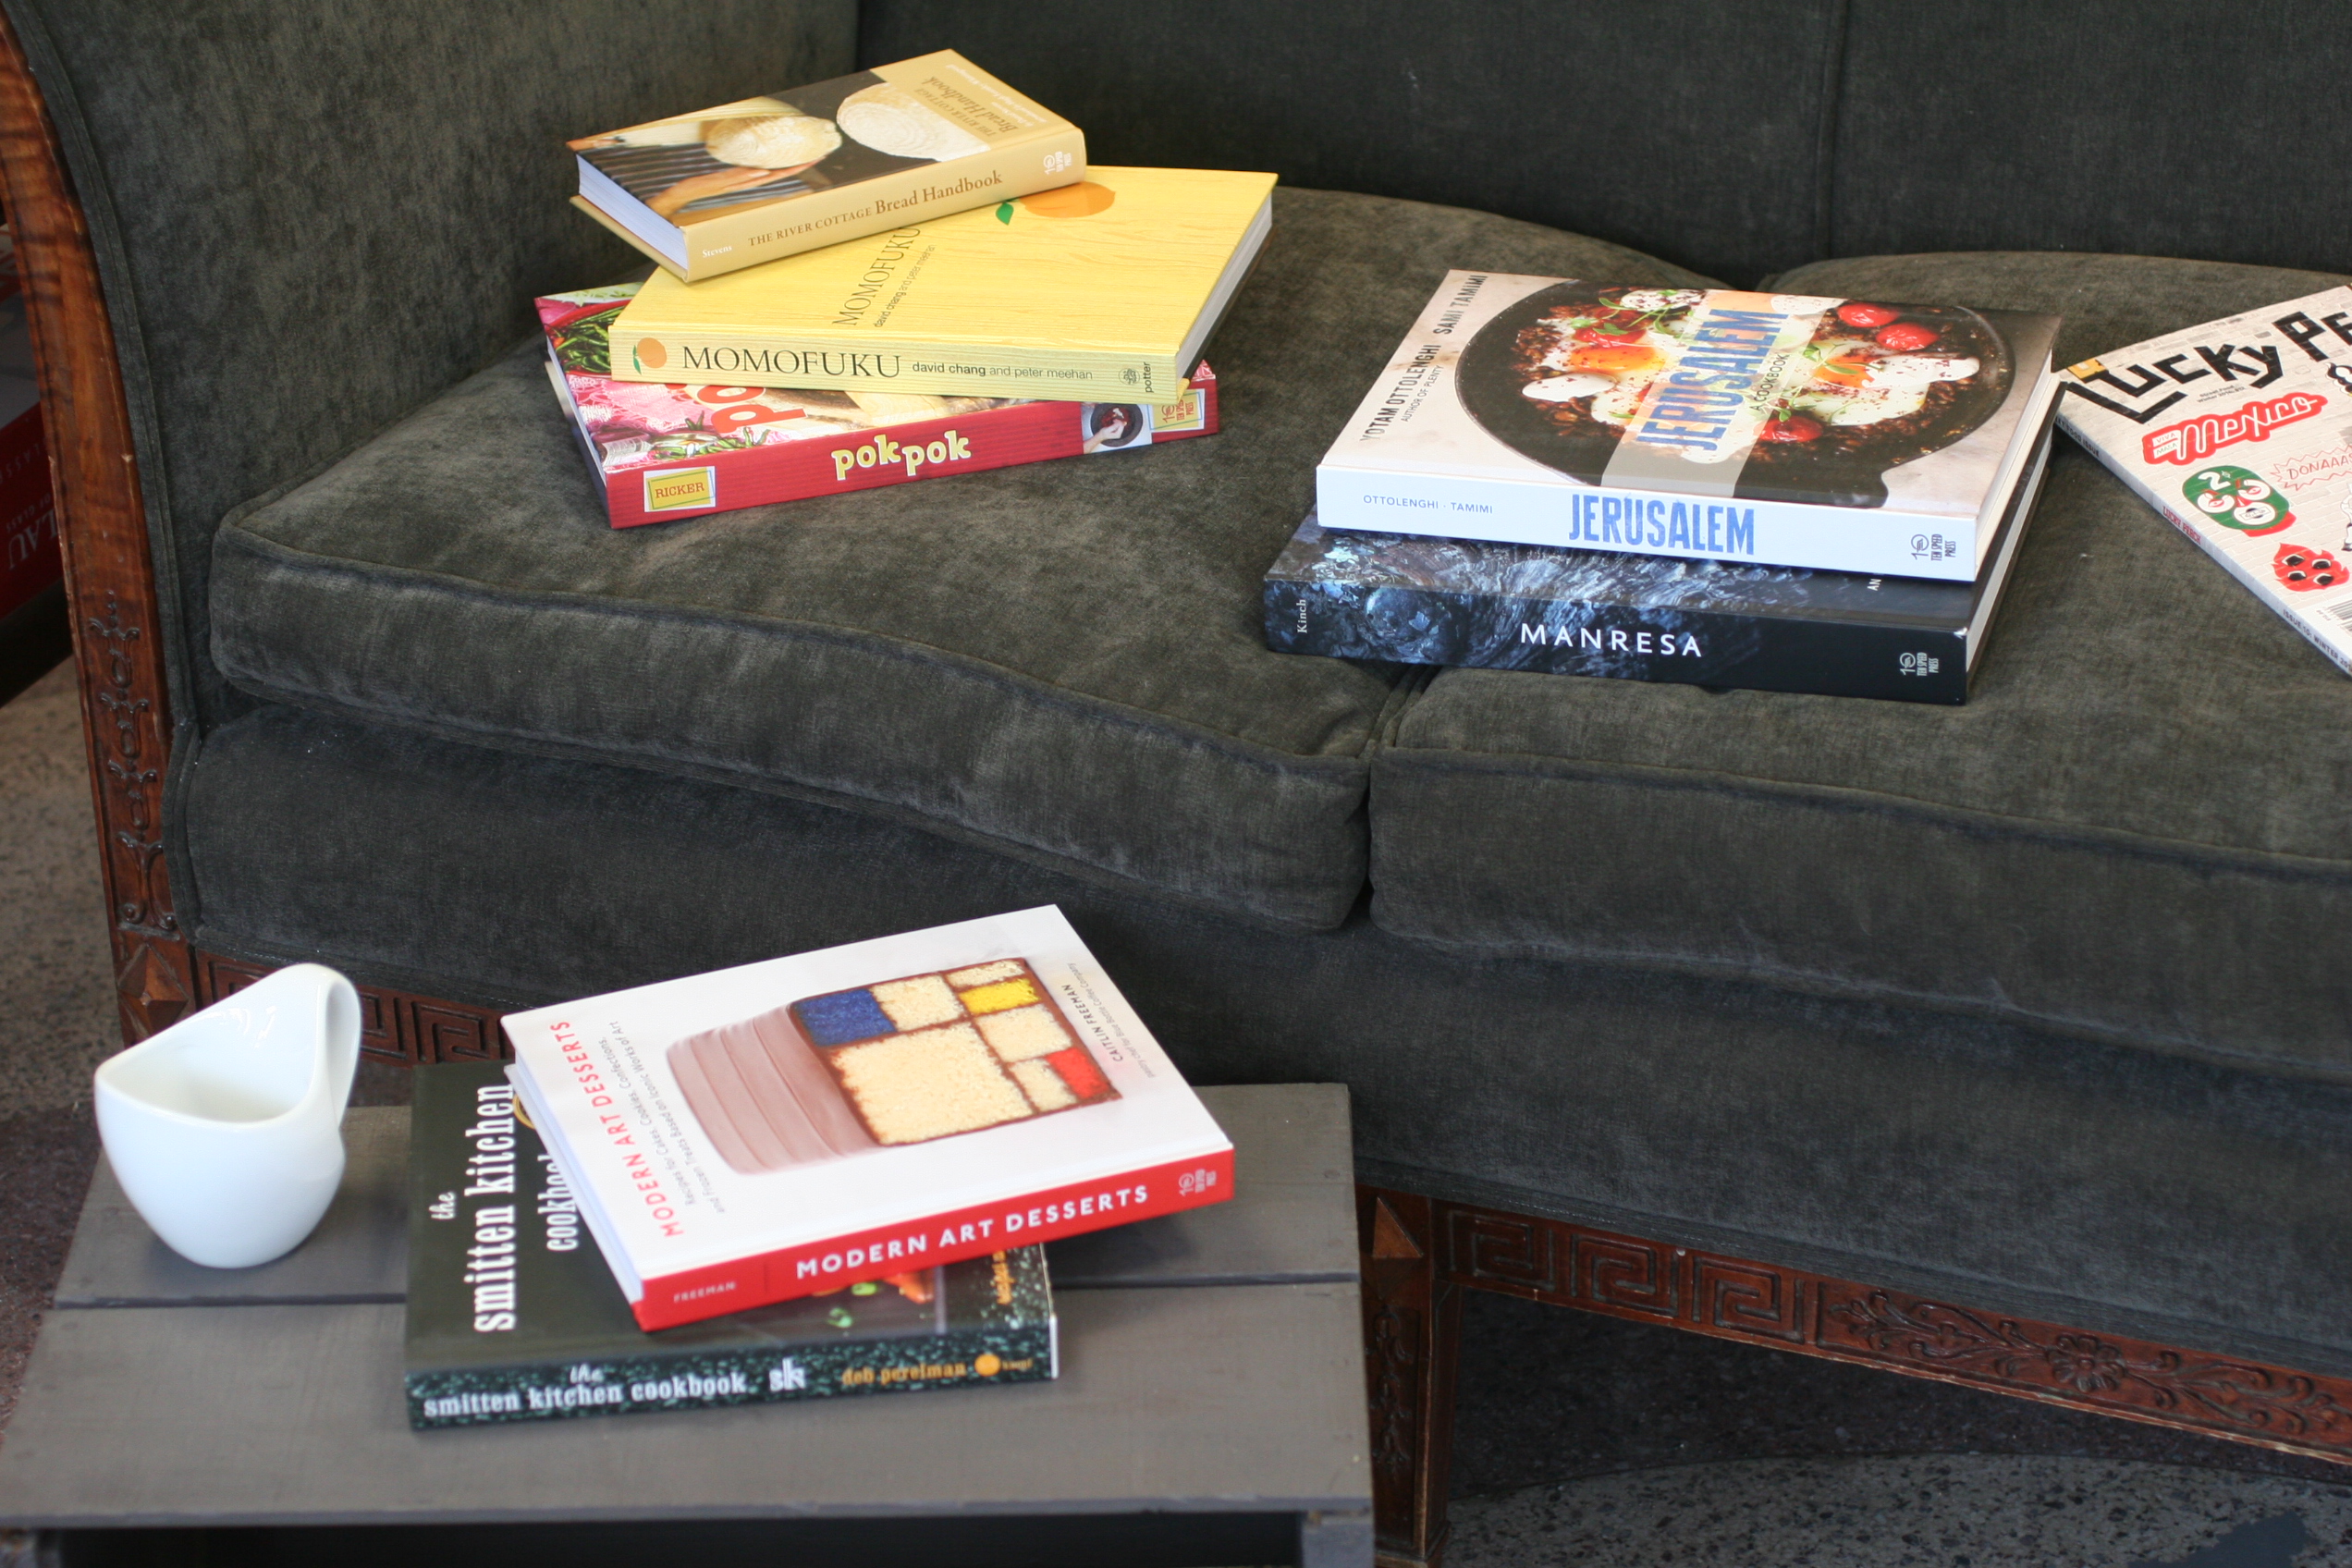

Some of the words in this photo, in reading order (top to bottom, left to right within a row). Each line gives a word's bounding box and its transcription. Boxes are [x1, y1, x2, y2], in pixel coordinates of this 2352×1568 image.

[748, 235, 773, 247] THE
[777, 223, 813, 239] RIVER
[815, 207, 872, 229] COTTAGE
[875, 191, 919, 214] Bread
[923, 170, 1002, 202] Handbook
[702, 245, 732, 258] Stevens
[832, 227, 921, 325] MOMOFUKU
[682, 345, 901, 378] MOMOFUKU
[913, 361, 945, 374] david
[949, 363, 986, 376] chang
[989, 365, 1011, 376] and
[1013, 367, 1044, 381] peter
[1047, 368, 1093, 380] meehan
[1359, 407, 1400, 441] YOTAM
[1385, 344, 1442, 406] OTTOLENGHI
[1433, 310, 1465, 335] SAMI
[1450, 275, 1489, 307] TAMIMI
[1144, 361, 1154, 393] potter
[1401, 397, 1424, 423] AUTHOR
[1417, 387, 1429, 398] OF
[1424, 364, 1445, 388] PLENTY
[1635, 309, 1789, 451] JERUSALEM
[1754, 353, 1790, 403] COOKBOOK
[2156, 433, 2176, 443] VIVA
[2156, 443, 2178, 455] MASA
[655, 481, 705, 499] RICKER
[1363, 494, 1439, 510] OTTOLENGHI
[1450, 502, 1494, 514] TAMIMI
[1568, 493, 1756, 556] JERUSALEM
[1945, 540, 1956, 558] PRESS
[1296, 598, 1308, 634] Kinch
[1520, 622, 1702, 657] MANRESA
[2283, 609, 2301, 628] ISSUE
[2313, 635, 2339, 660] WINTER
[1929, 657, 1939, 674] PRESS
[1061, 984, 1097, 1024] FREEMAN
[608, 1022, 623, 1035] Art
[1092, 1026, 1123, 1062] CAITLIN
[549, 1021, 613, 1108] DESSERTS
[625, 1047, 644, 1072] Works
[464, 1084, 515, 1196] kitchen
[599, 1114, 636, 1145] ART
[428, 1191, 457, 1220] the
[622, 1154, 683, 1236] MODERN
[673, 1280, 737, 1304] FREEMAN
[796, 1234, 928, 1280] MODERN
[939, 1219, 994, 1248] ART
[1006, 1185, 1149, 1232] DESSERTS
[463, 1205, 516, 1332] smitten
[423, 1392, 521, 1418] smitten
[527, 1382, 623, 1410] kitchen
[631, 1371, 747, 1402] cookbook
[769, 1357, 806, 1392] sk
[841, 1366, 875, 1385] deb
[880, 1361, 967, 1386] perelman
[570, 1364, 604, 1383] the
